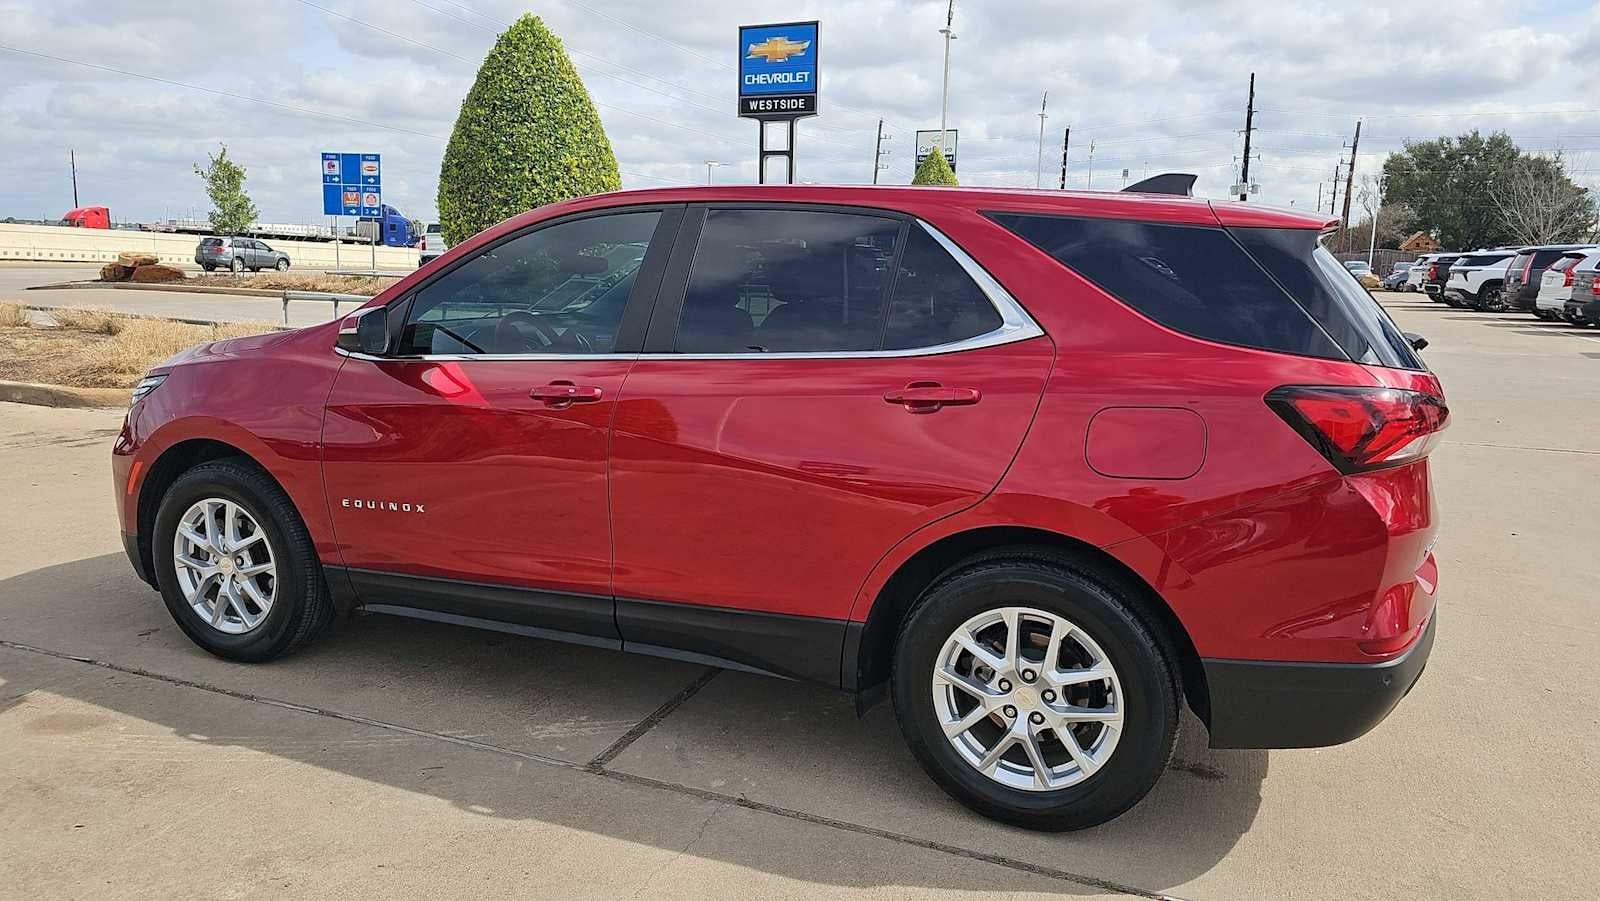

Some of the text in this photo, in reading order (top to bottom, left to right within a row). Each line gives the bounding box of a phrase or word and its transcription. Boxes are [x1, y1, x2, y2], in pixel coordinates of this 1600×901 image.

[744, 71, 810, 85] CHEVROLET
[749, 98, 806, 111] WESTSIDE
[342, 498, 425, 513] EQUINOX
